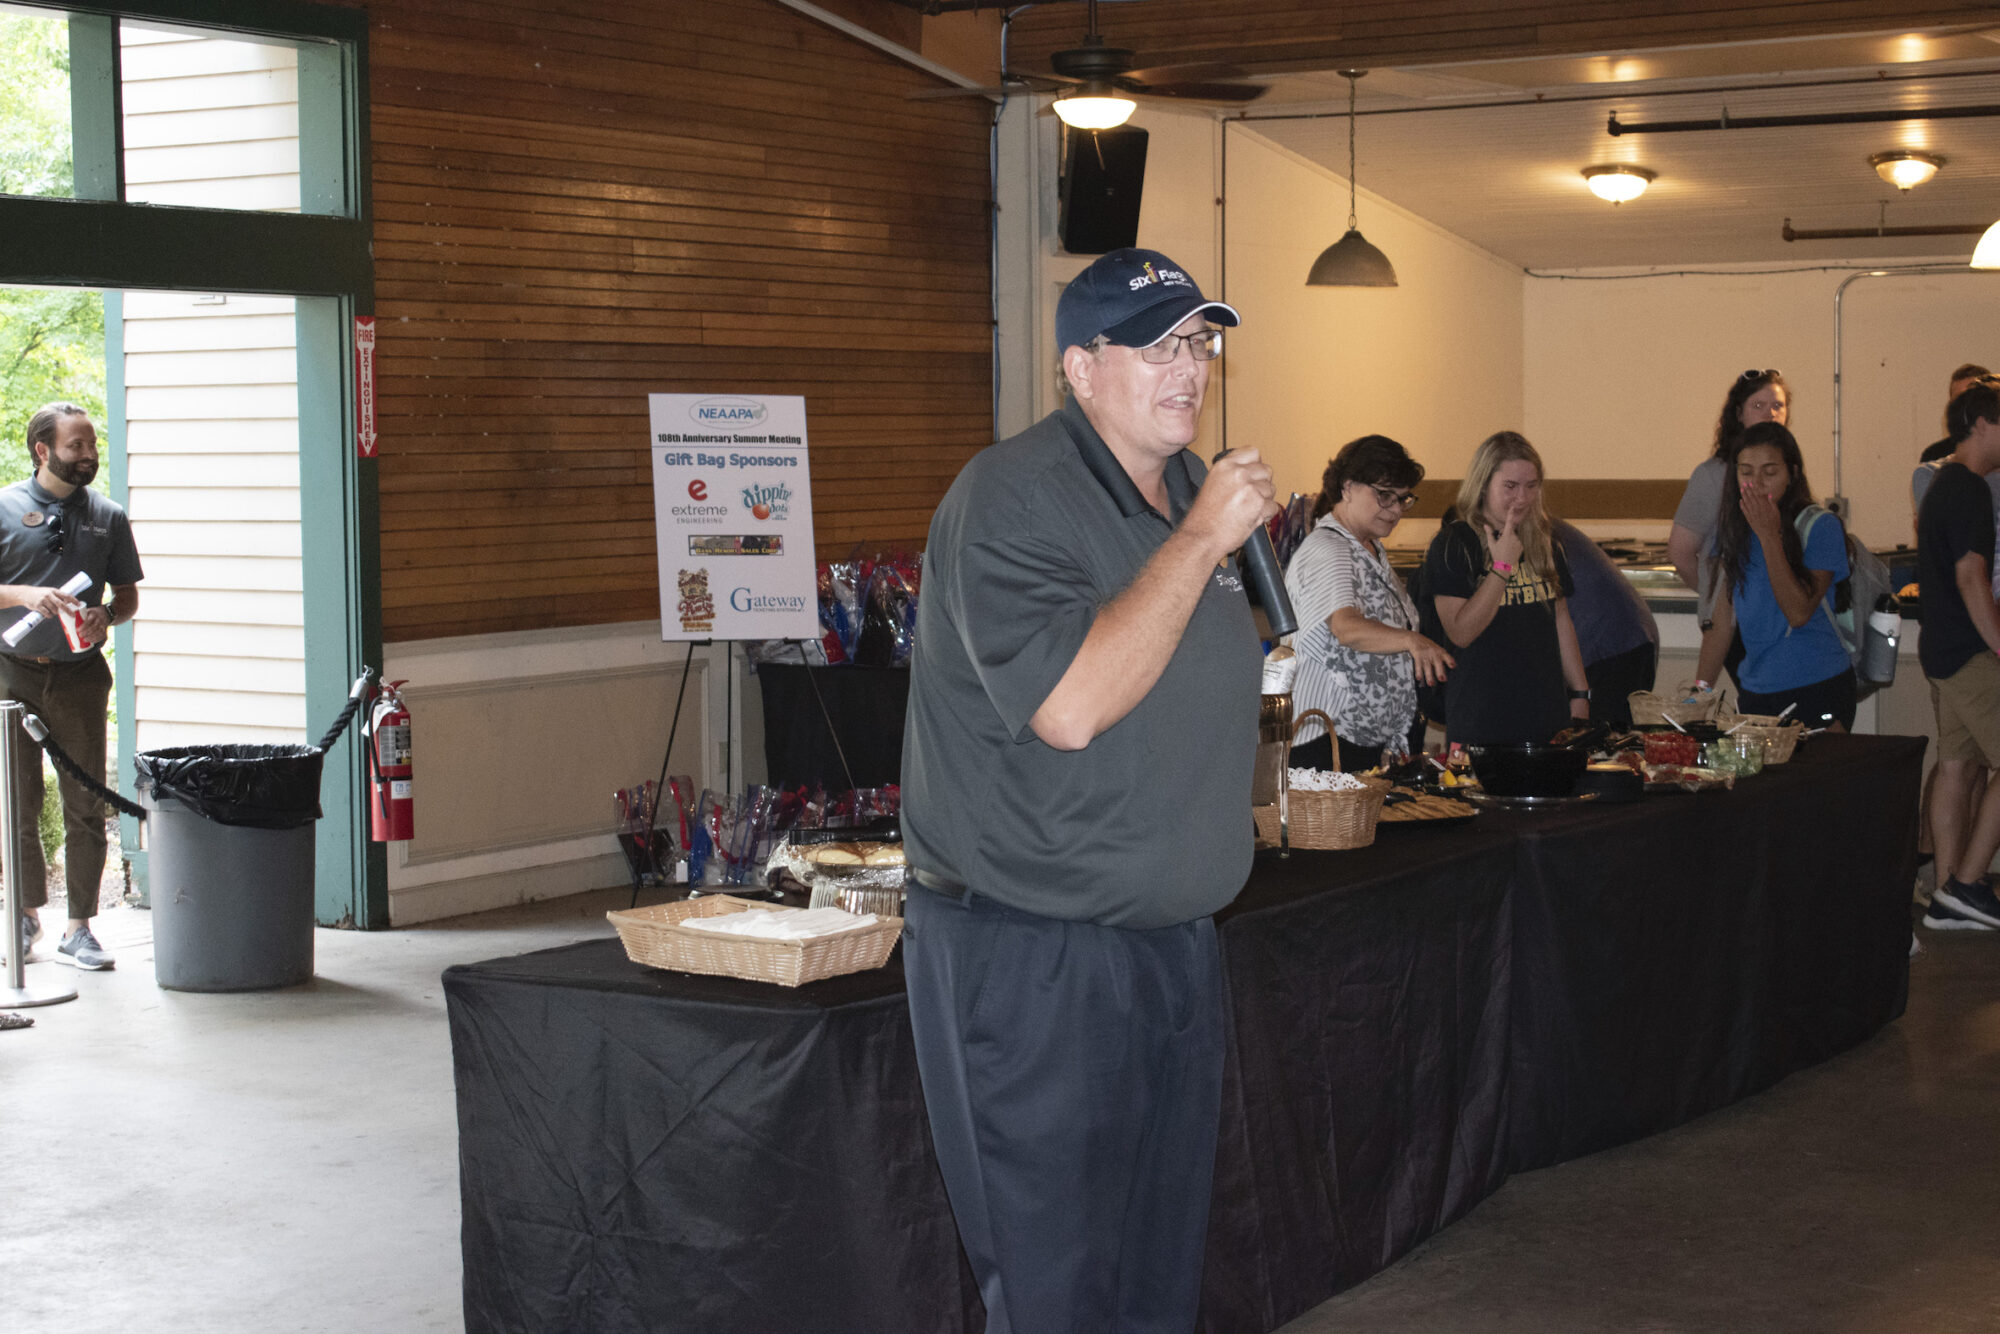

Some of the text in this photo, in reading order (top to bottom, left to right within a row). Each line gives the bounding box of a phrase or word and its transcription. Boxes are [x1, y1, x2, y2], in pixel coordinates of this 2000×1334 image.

[358, 329, 374, 343] FIRE
[363, 347, 372, 447] EXTINGUISHER
[698, 408, 754, 420] NEAAPA
[657, 433, 802, 445] 108th Anniversary Summer Meeting
[664, 452, 798, 469] Gift Bag Sponsors
[671, 504, 728, 516] extreme
[676, 517, 724, 525] ENGINEERING
[730, 587, 807, 612] Gateway
